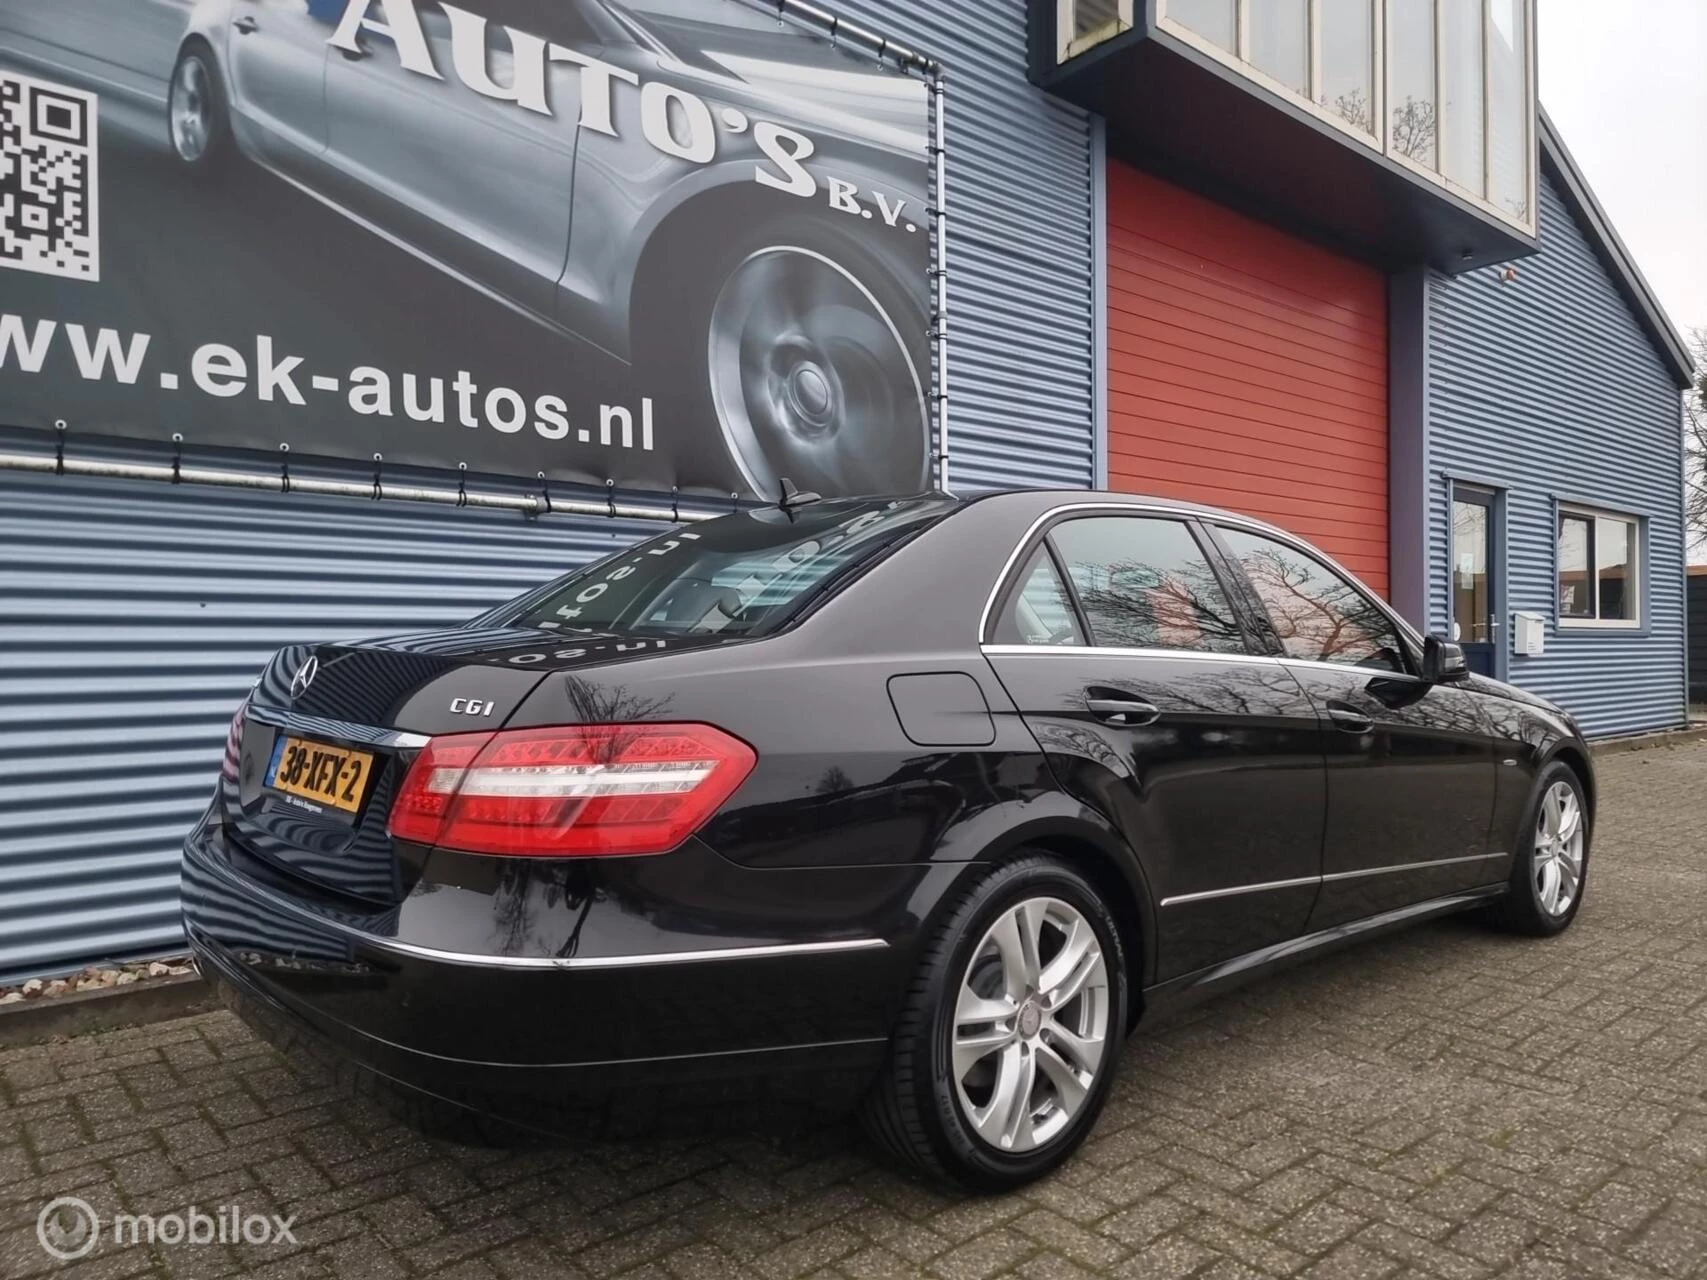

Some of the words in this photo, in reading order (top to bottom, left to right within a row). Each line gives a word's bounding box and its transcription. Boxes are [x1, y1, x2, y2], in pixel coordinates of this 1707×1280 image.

[827, 175, 917, 233] B.V.
[450, 698, 494, 716] CGI
[280, 745, 362, 802] 38-XFX-2
